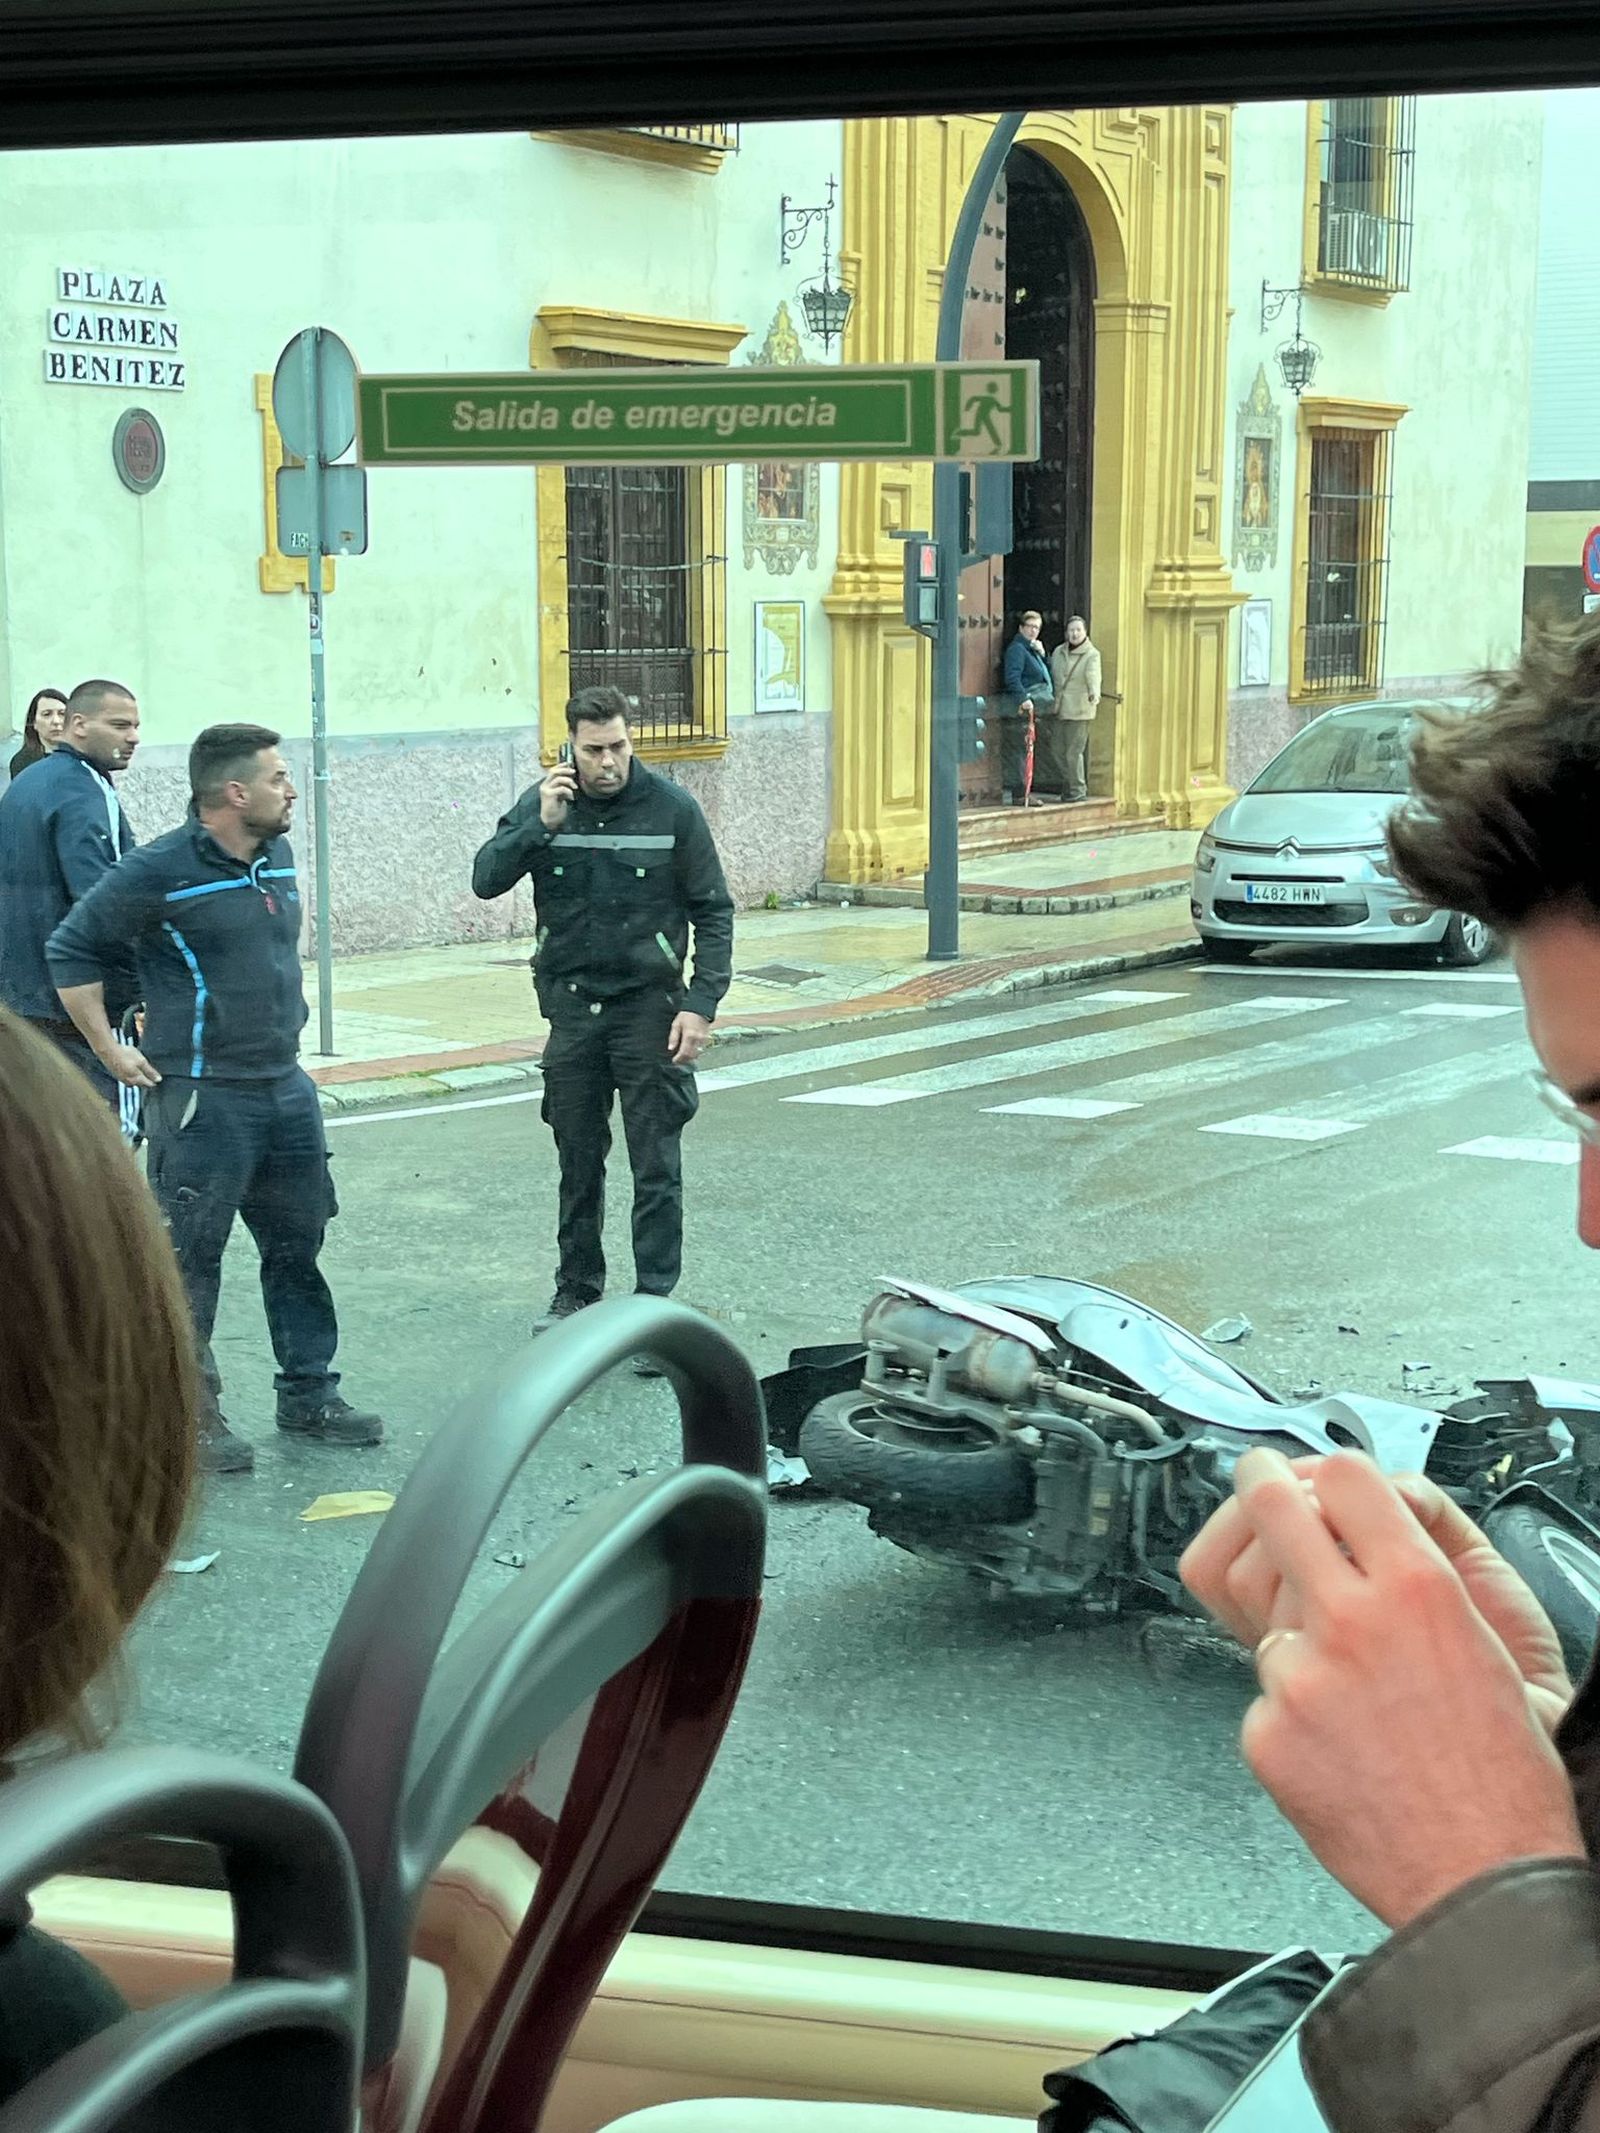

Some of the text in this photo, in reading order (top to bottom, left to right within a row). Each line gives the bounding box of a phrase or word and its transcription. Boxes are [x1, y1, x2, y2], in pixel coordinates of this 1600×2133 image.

[62, 272, 167, 306] PLAZA
[53, 312, 178, 348] CARMEN
[49, 353, 185, 387] BENITEZ
[452, 395, 837, 436] Salida de emergencia
[1253, 887, 1288, 901] 4482
